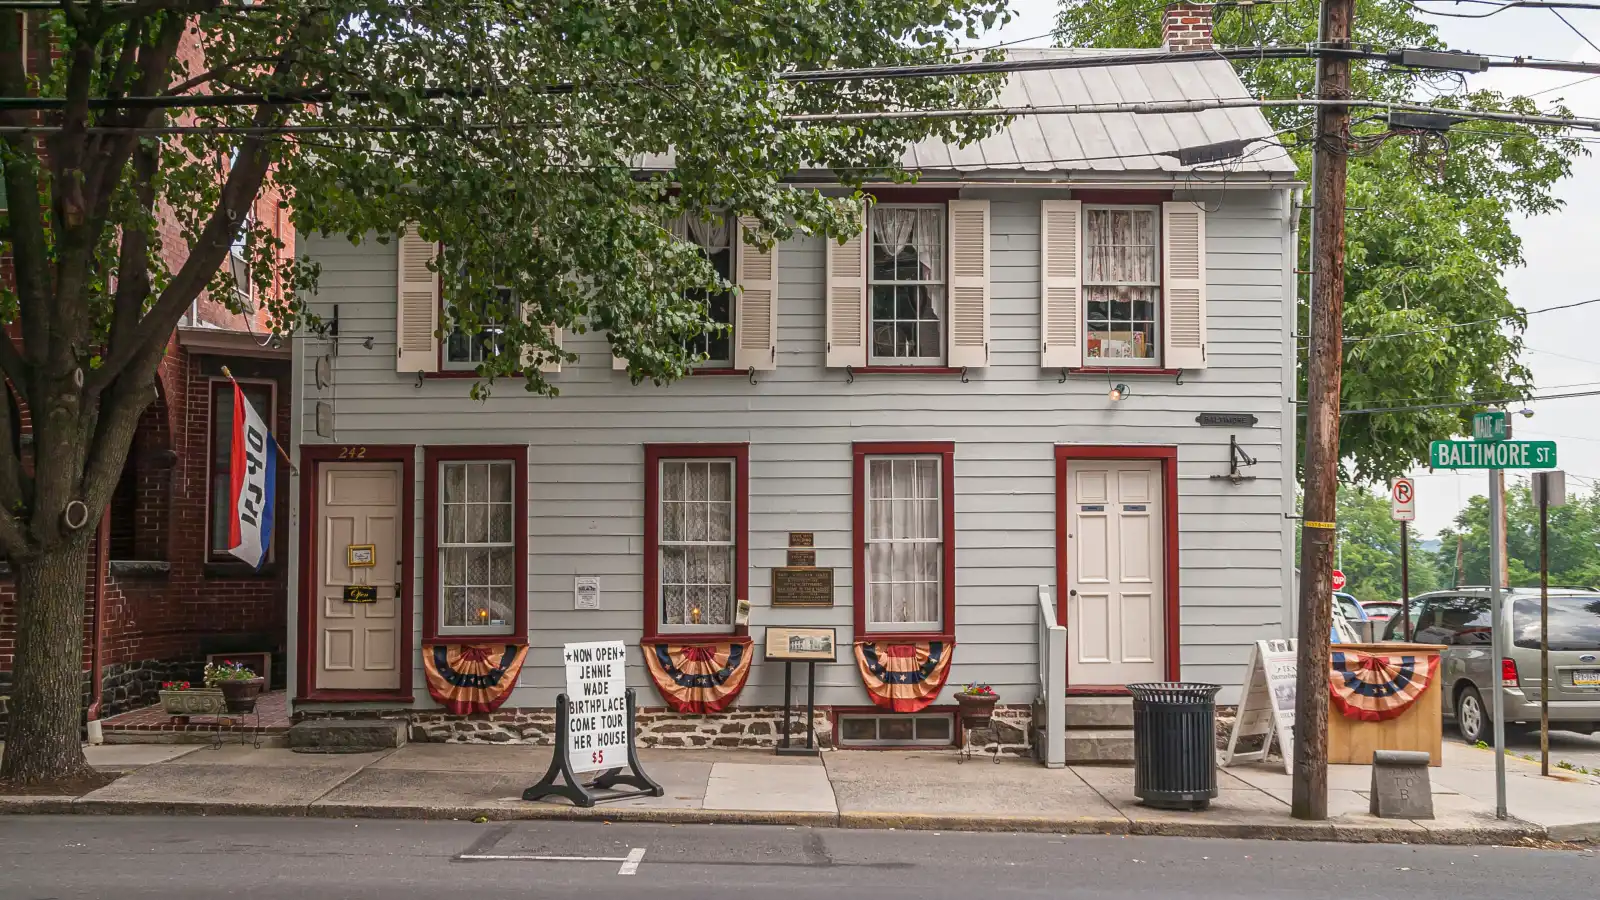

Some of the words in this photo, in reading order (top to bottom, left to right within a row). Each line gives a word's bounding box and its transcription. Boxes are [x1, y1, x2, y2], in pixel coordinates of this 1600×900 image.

[1474, 415, 1494, 438] WADE
[1494, 419, 1504, 434] AVE
[338, 446, 367, 459] 242
[1438, 443, 1531, 466] BALTIMORE
[1536, 447, 1550, 463] ST
[1332, 575, 1344, 585] TOP
[573, 648, 592, 663] NOW
[596, 647, 618, 661] OPEN
[580, 664, 611, 679] JENNIE
[583, 682, 609, 696] WADE
[569, 697, 624, 715] BIRTHPLACE
[570, 717, 596, 732] COME
[601, 714, 623, 729] TOUR
[574, 734, 592, 749] HER
[597, 731, 626, 747] HOUSE
[592, 750, 604, 764] $5
[1395, 777, 1414, 788] TO
[1399, 788, 1410, 800] B
